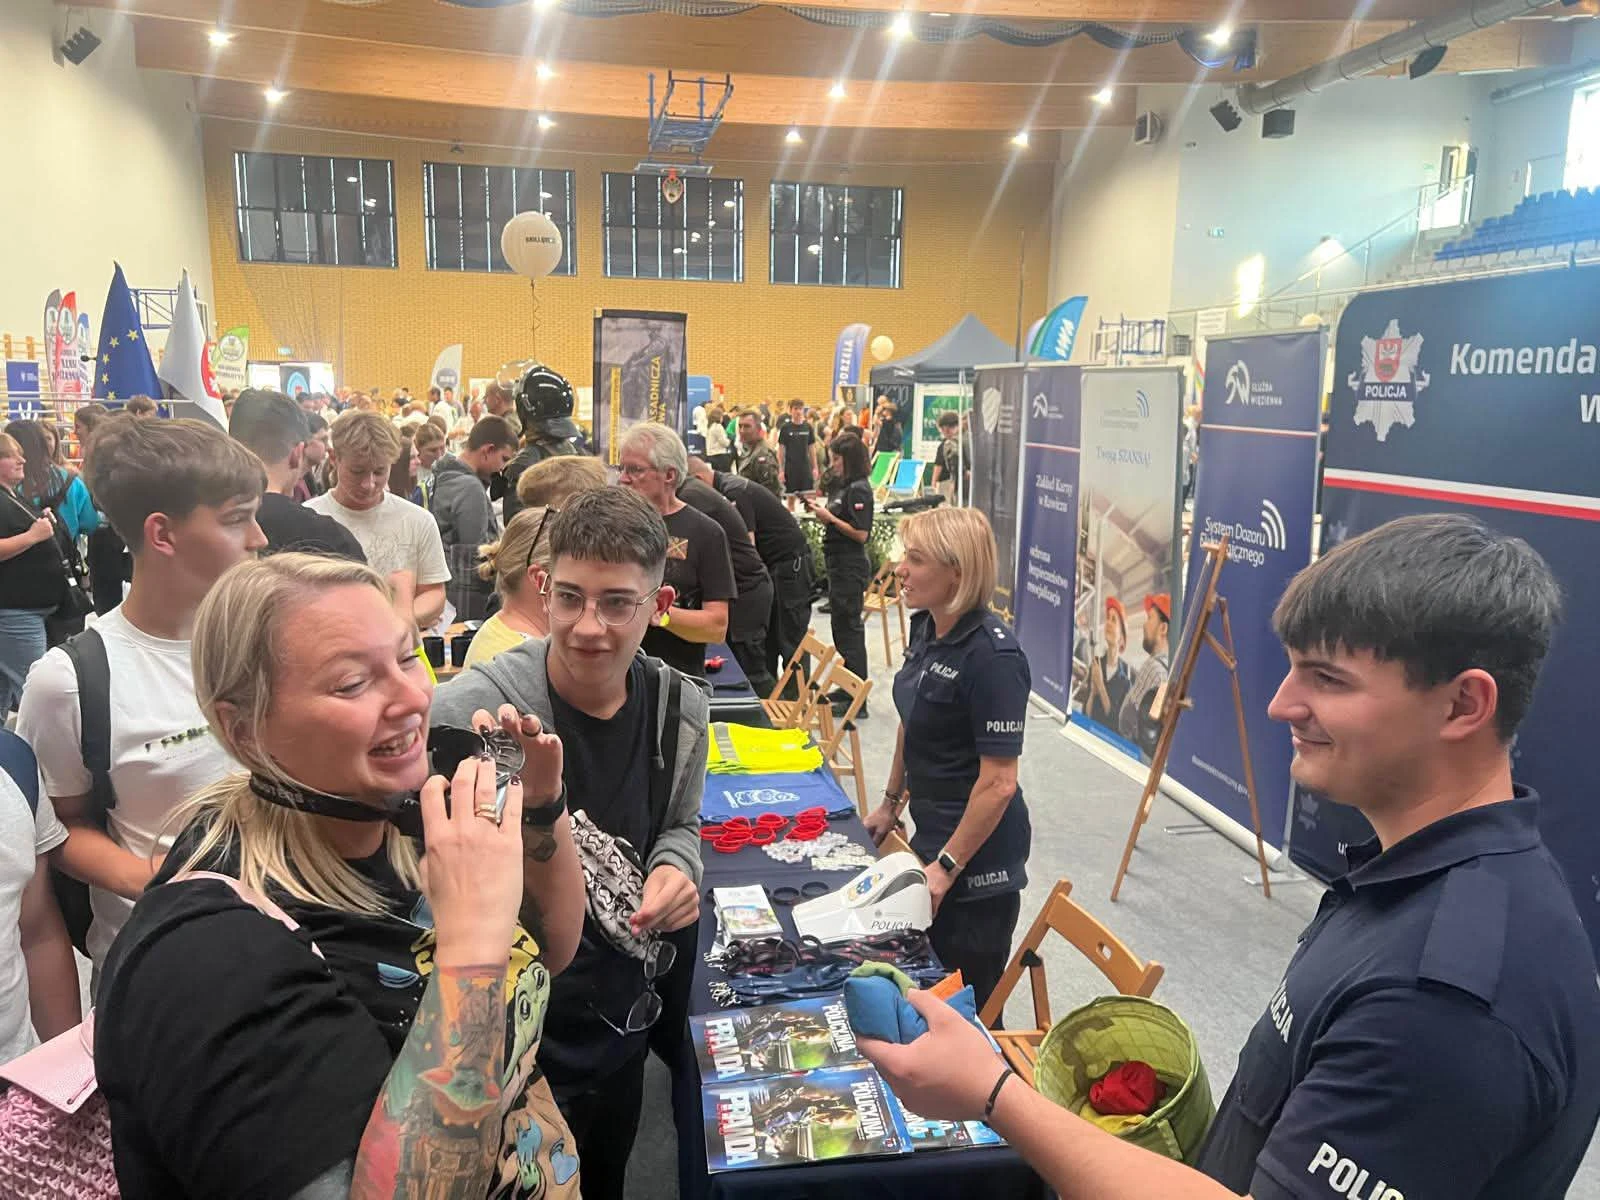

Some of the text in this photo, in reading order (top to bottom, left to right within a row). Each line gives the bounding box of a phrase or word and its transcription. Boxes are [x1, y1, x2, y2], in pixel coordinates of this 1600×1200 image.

[1449, 337, 1597, 375] Komenda
[1365, 383, 1407, 399] POLICJA
[1204, 516, 1266, 547] System Dozoru
[967, 869, 1010, 889] POLICJA
